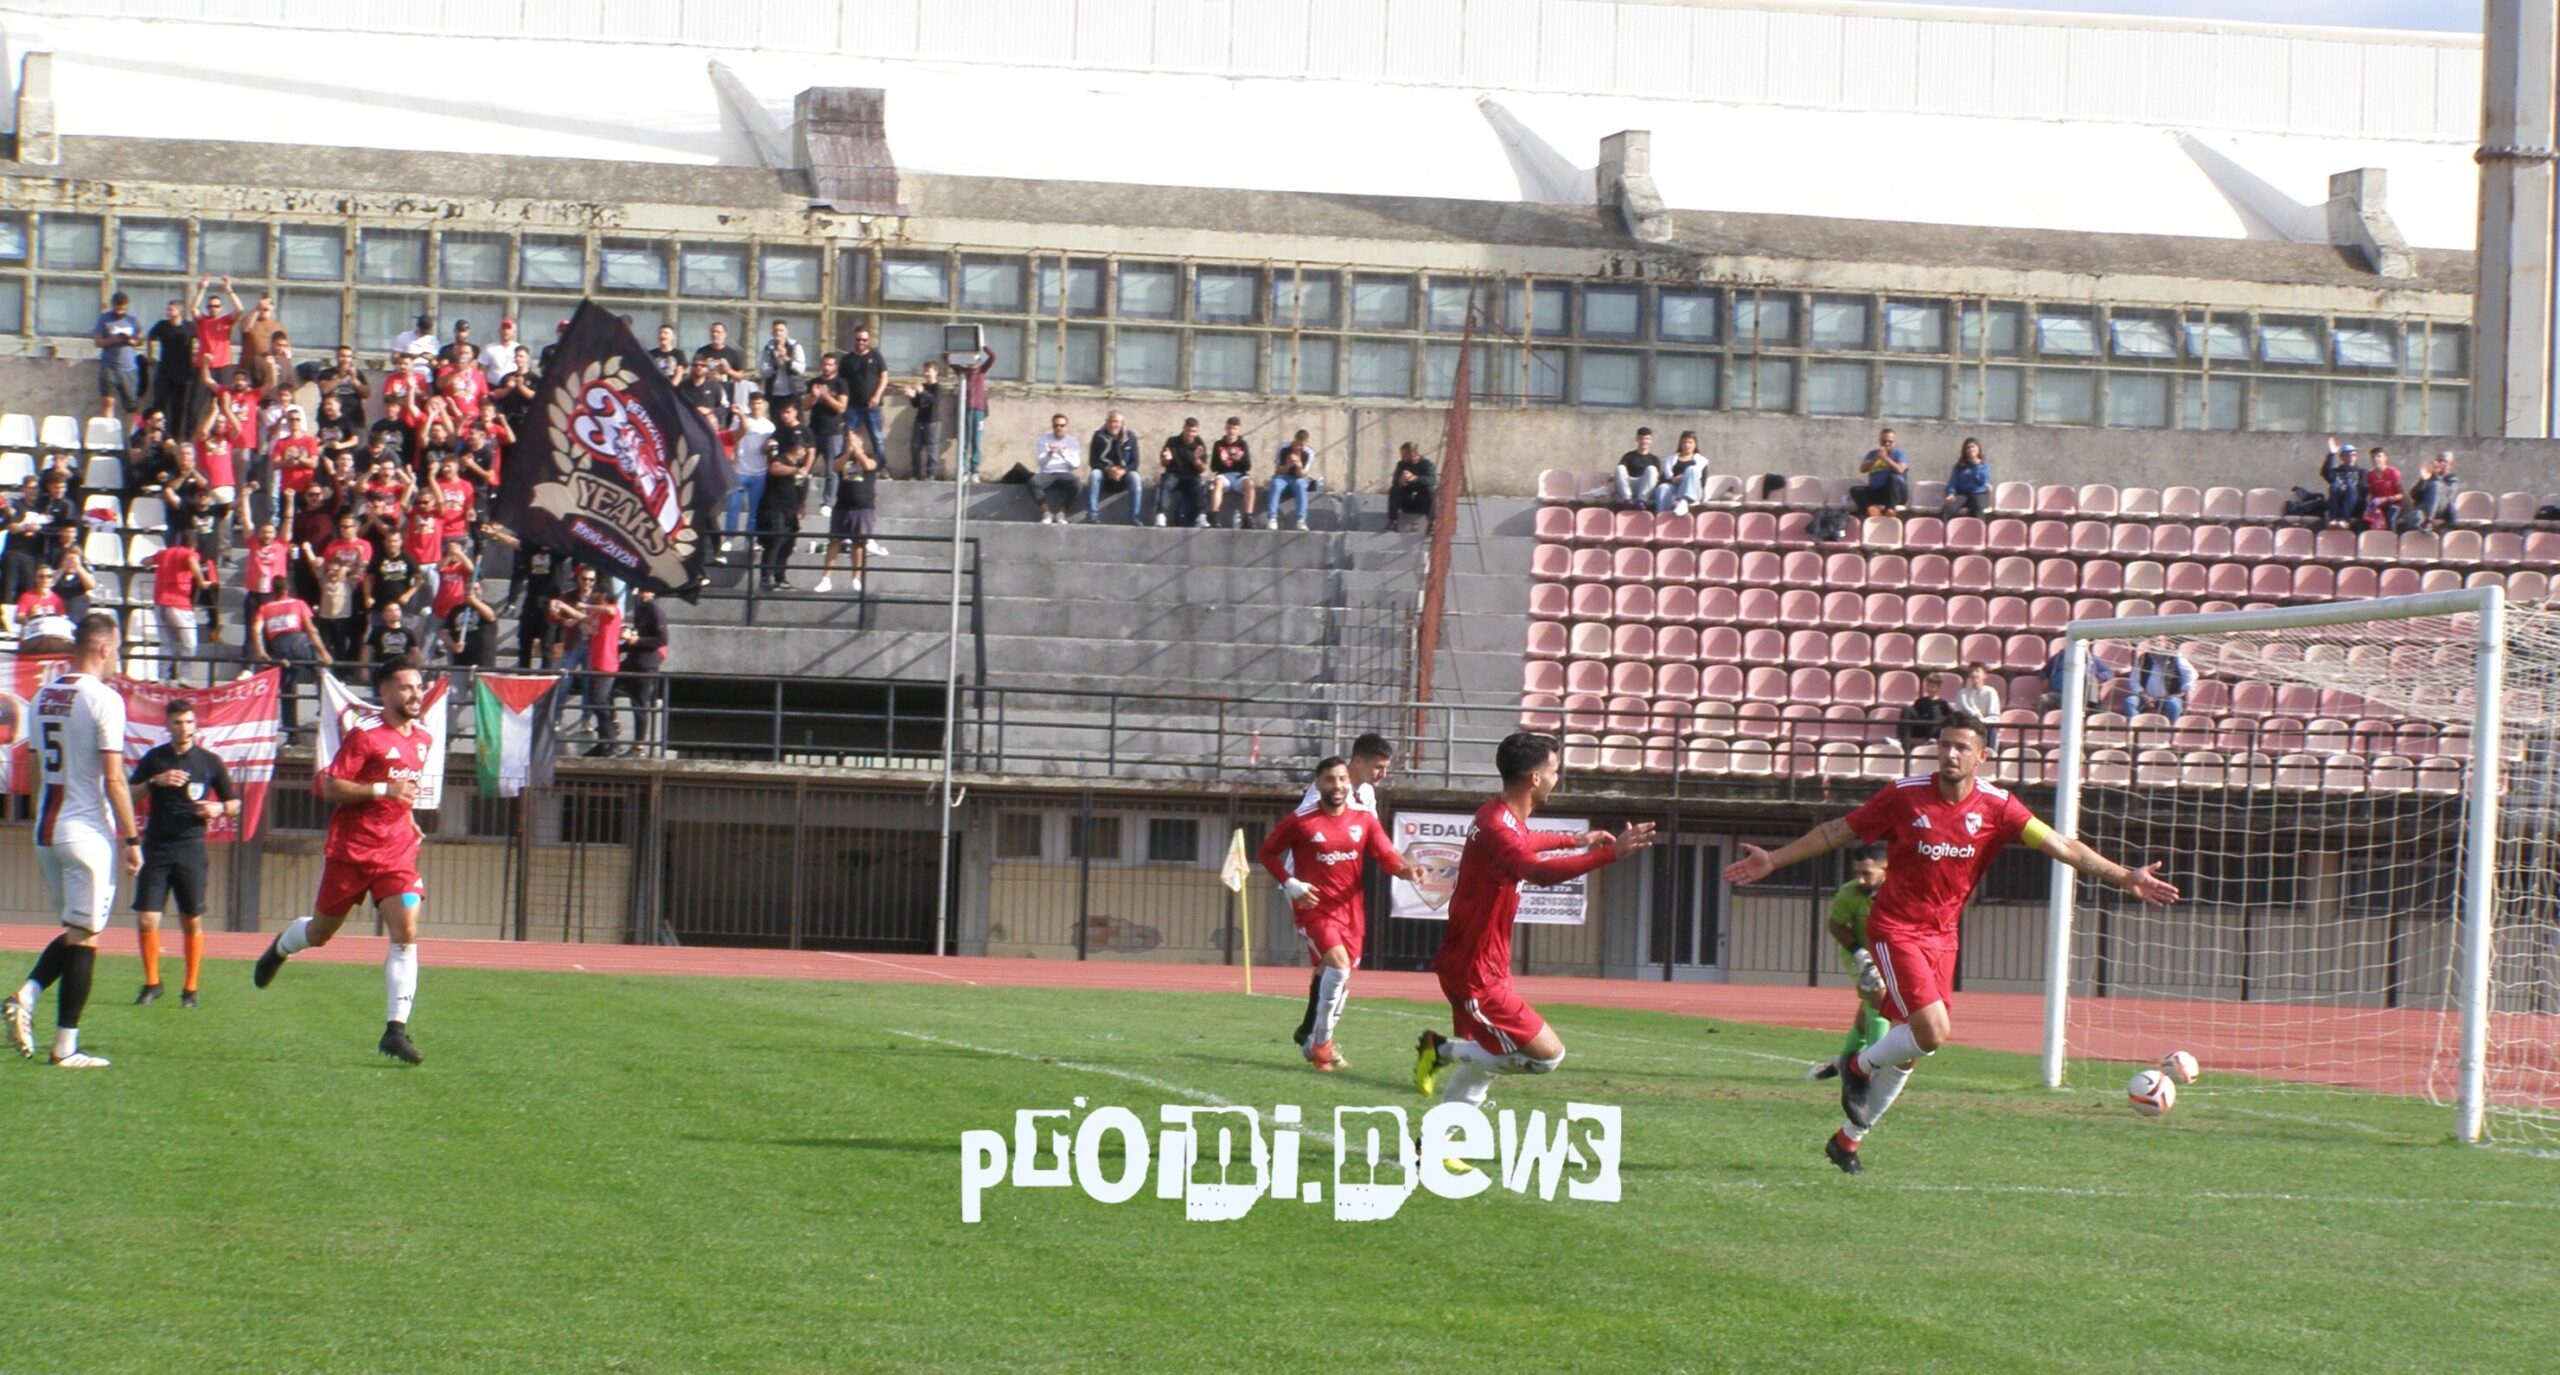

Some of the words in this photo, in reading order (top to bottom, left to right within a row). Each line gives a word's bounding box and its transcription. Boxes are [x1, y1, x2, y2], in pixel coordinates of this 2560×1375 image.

[576, 475, 668, 556] YEARS
[43, 722, 62, 772] 5
[1405, 822, 1470, 838] DEDAL
[1918, 841, 1976, 861] logitech
